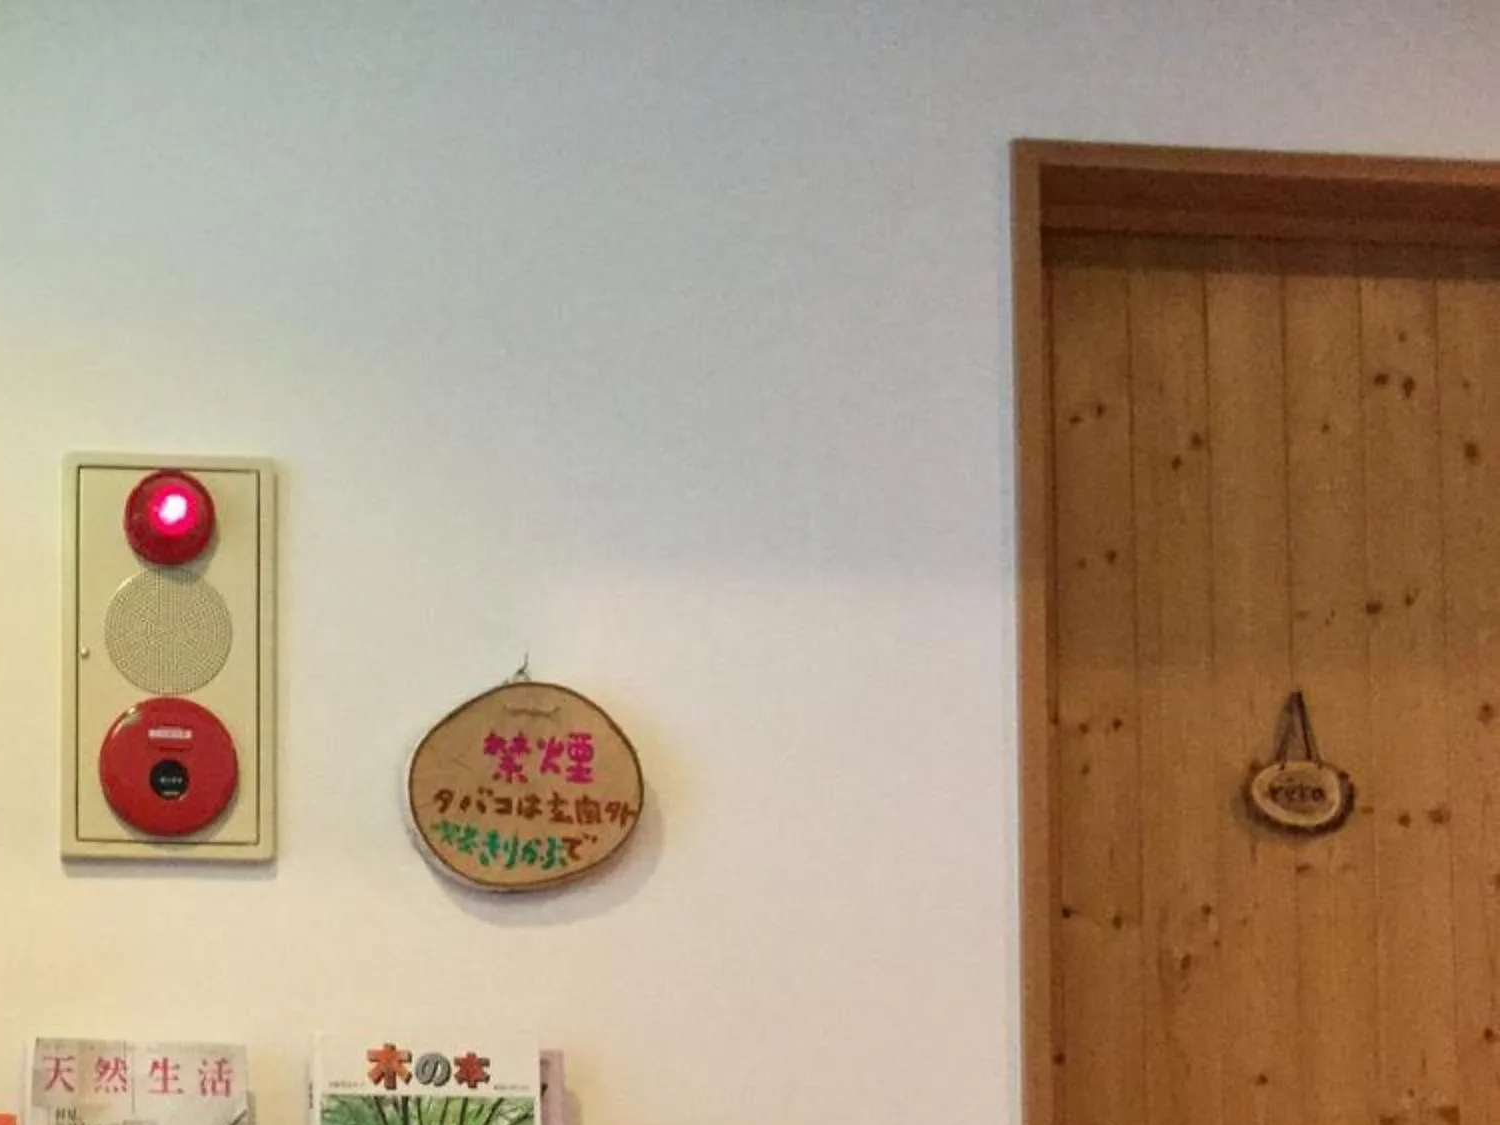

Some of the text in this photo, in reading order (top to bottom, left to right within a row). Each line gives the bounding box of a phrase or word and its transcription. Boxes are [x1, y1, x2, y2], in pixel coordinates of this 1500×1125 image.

[483, 731, 595, 784] 禁煙
[43, 1055, 234, 1097] 天然生活
[367, 1043, 491, 1090] 木の本
